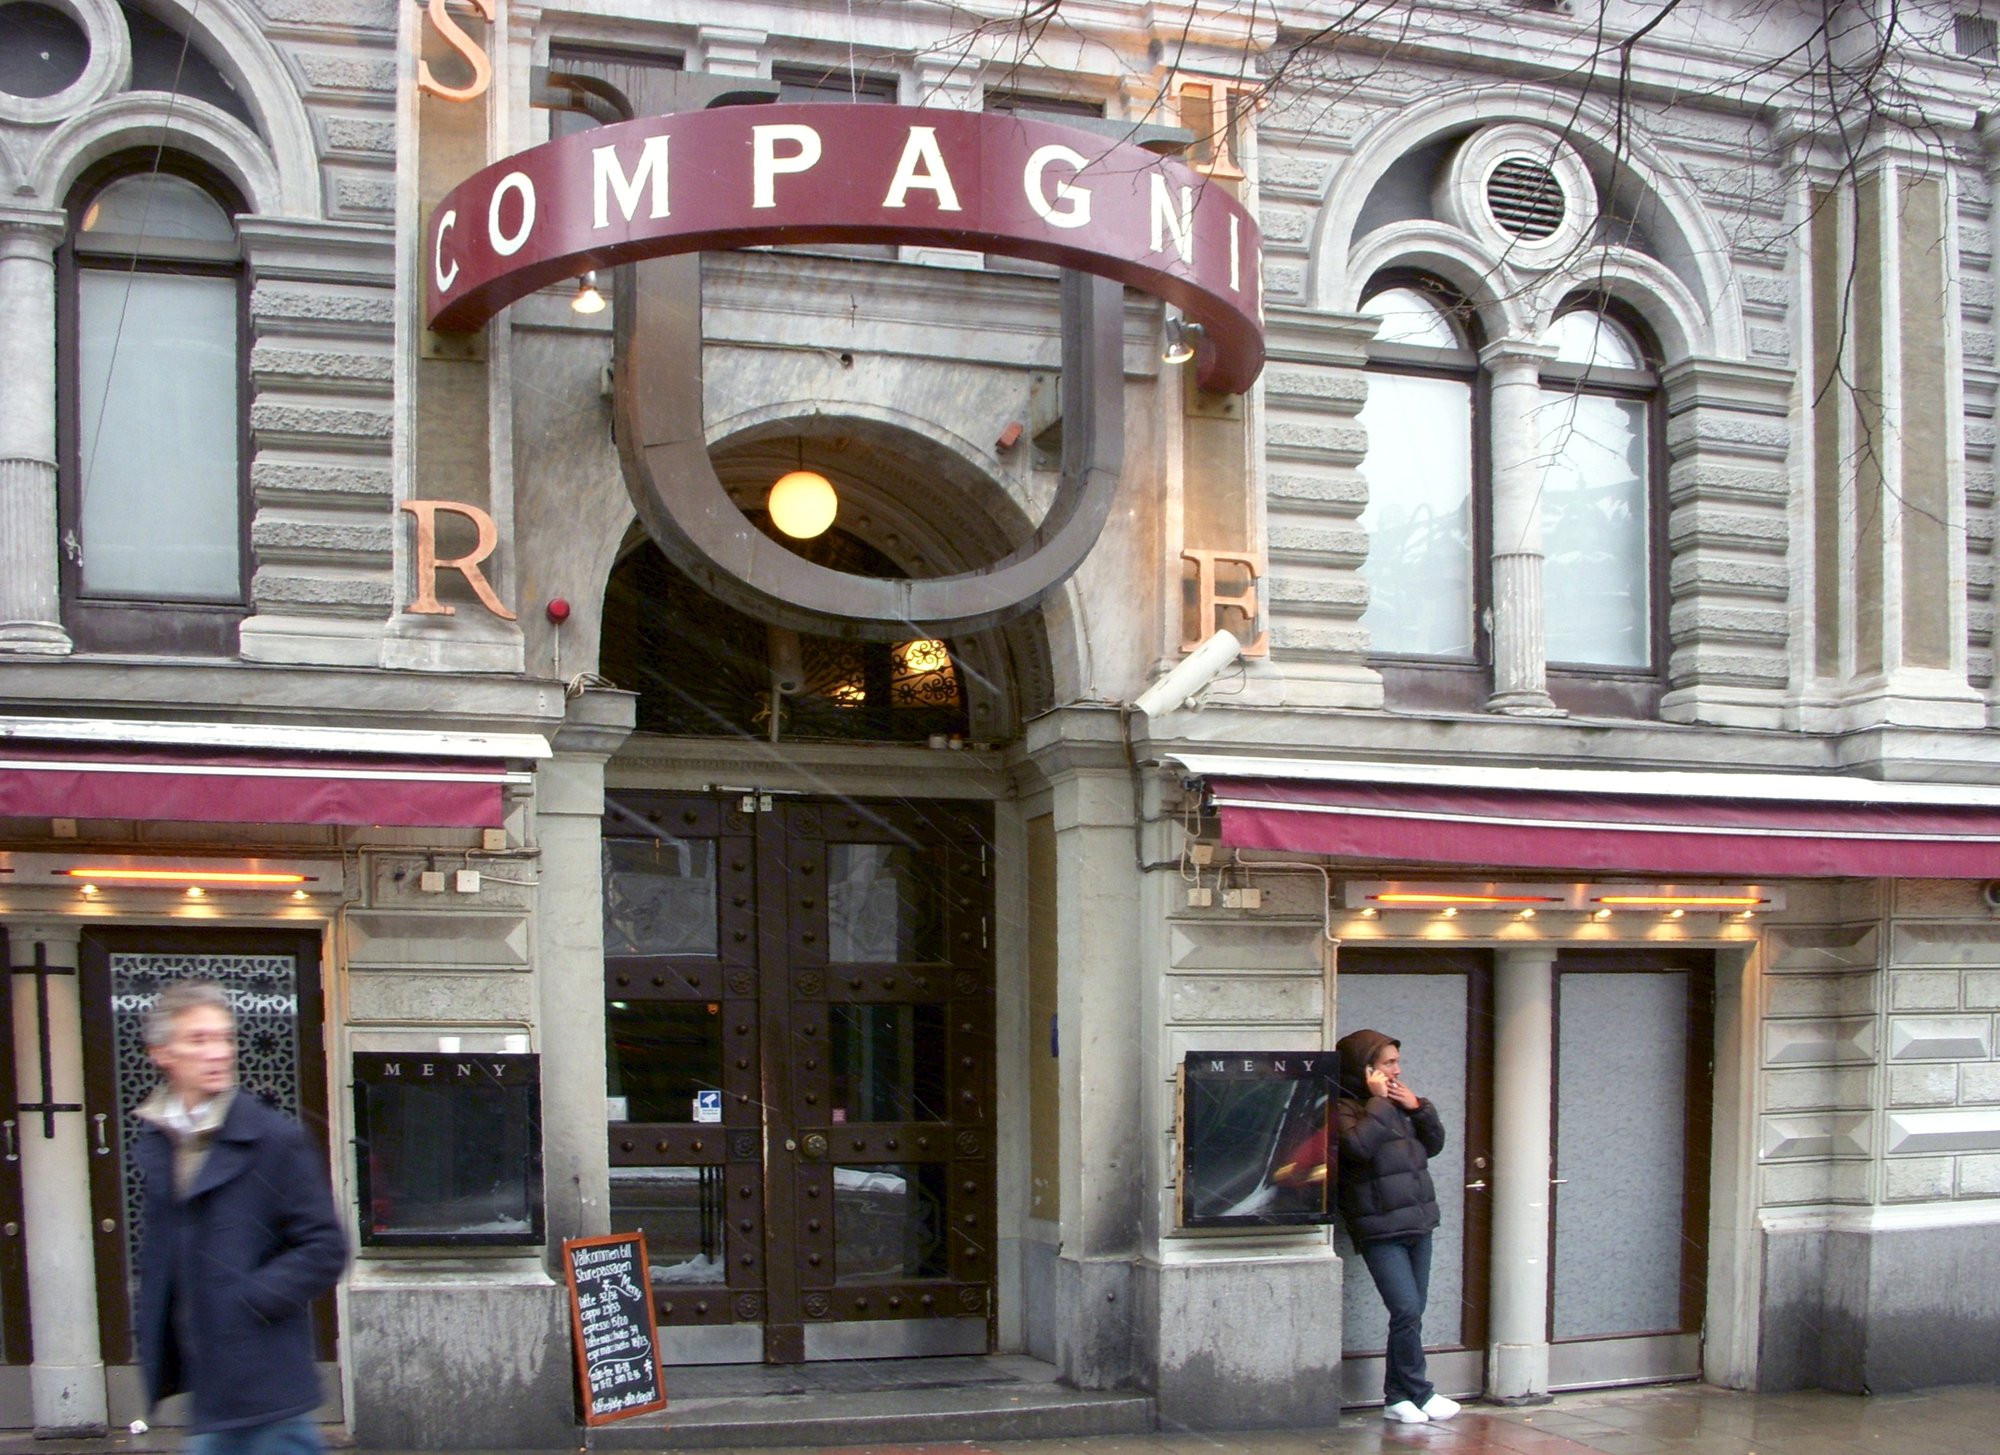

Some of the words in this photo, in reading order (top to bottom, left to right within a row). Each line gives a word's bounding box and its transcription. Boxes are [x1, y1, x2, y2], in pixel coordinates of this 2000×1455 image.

[433, 122, 1266, 328] COMPAGNI
[400, 499, 518, 621] R
[384, 1063, 507, 1077] MENY
[1210, 1060, 1315, 1073] MENY
